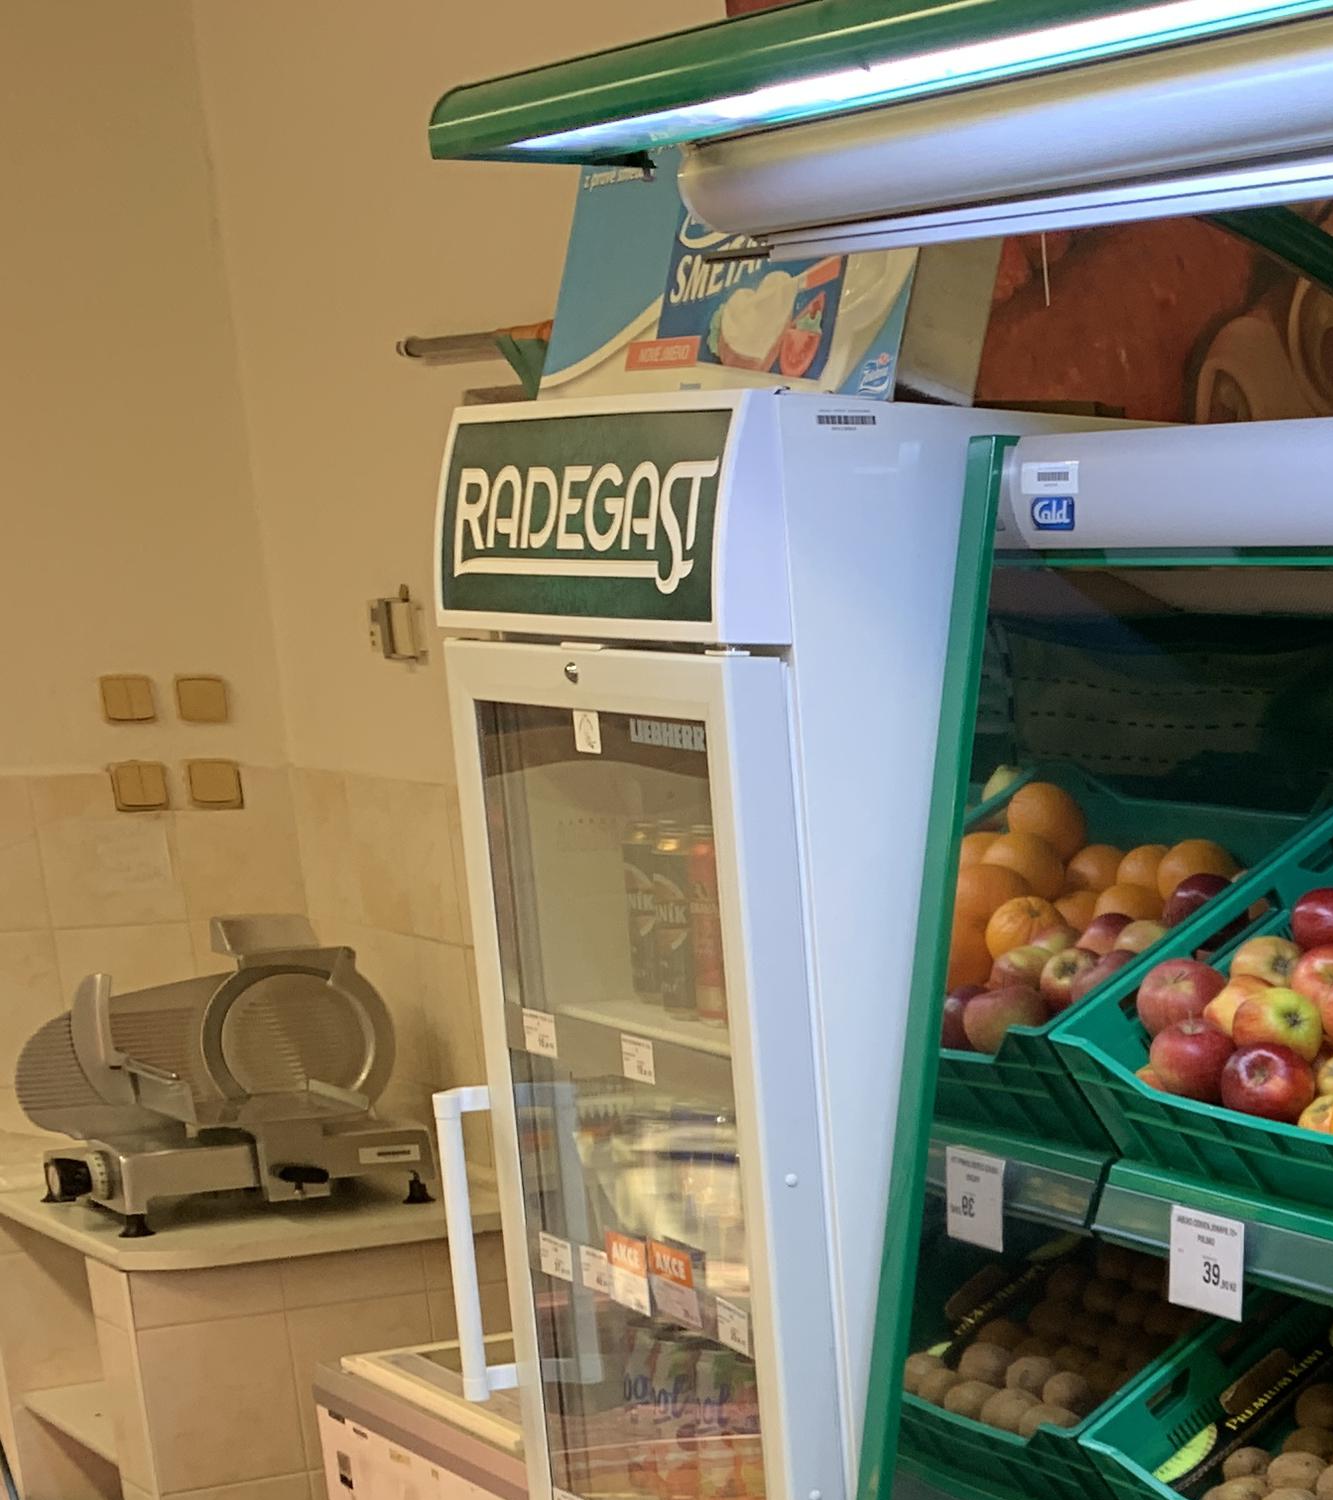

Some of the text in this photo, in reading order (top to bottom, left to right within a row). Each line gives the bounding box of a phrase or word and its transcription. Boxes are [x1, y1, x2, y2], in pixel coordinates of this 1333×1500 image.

[454, 455, 720, 594] RADEGAST
[629, 718, 706, 752] LIEBHERR
[611, 1241, 640, 1268] AKCE
[655, 1252, 687, 1281] AKCE
